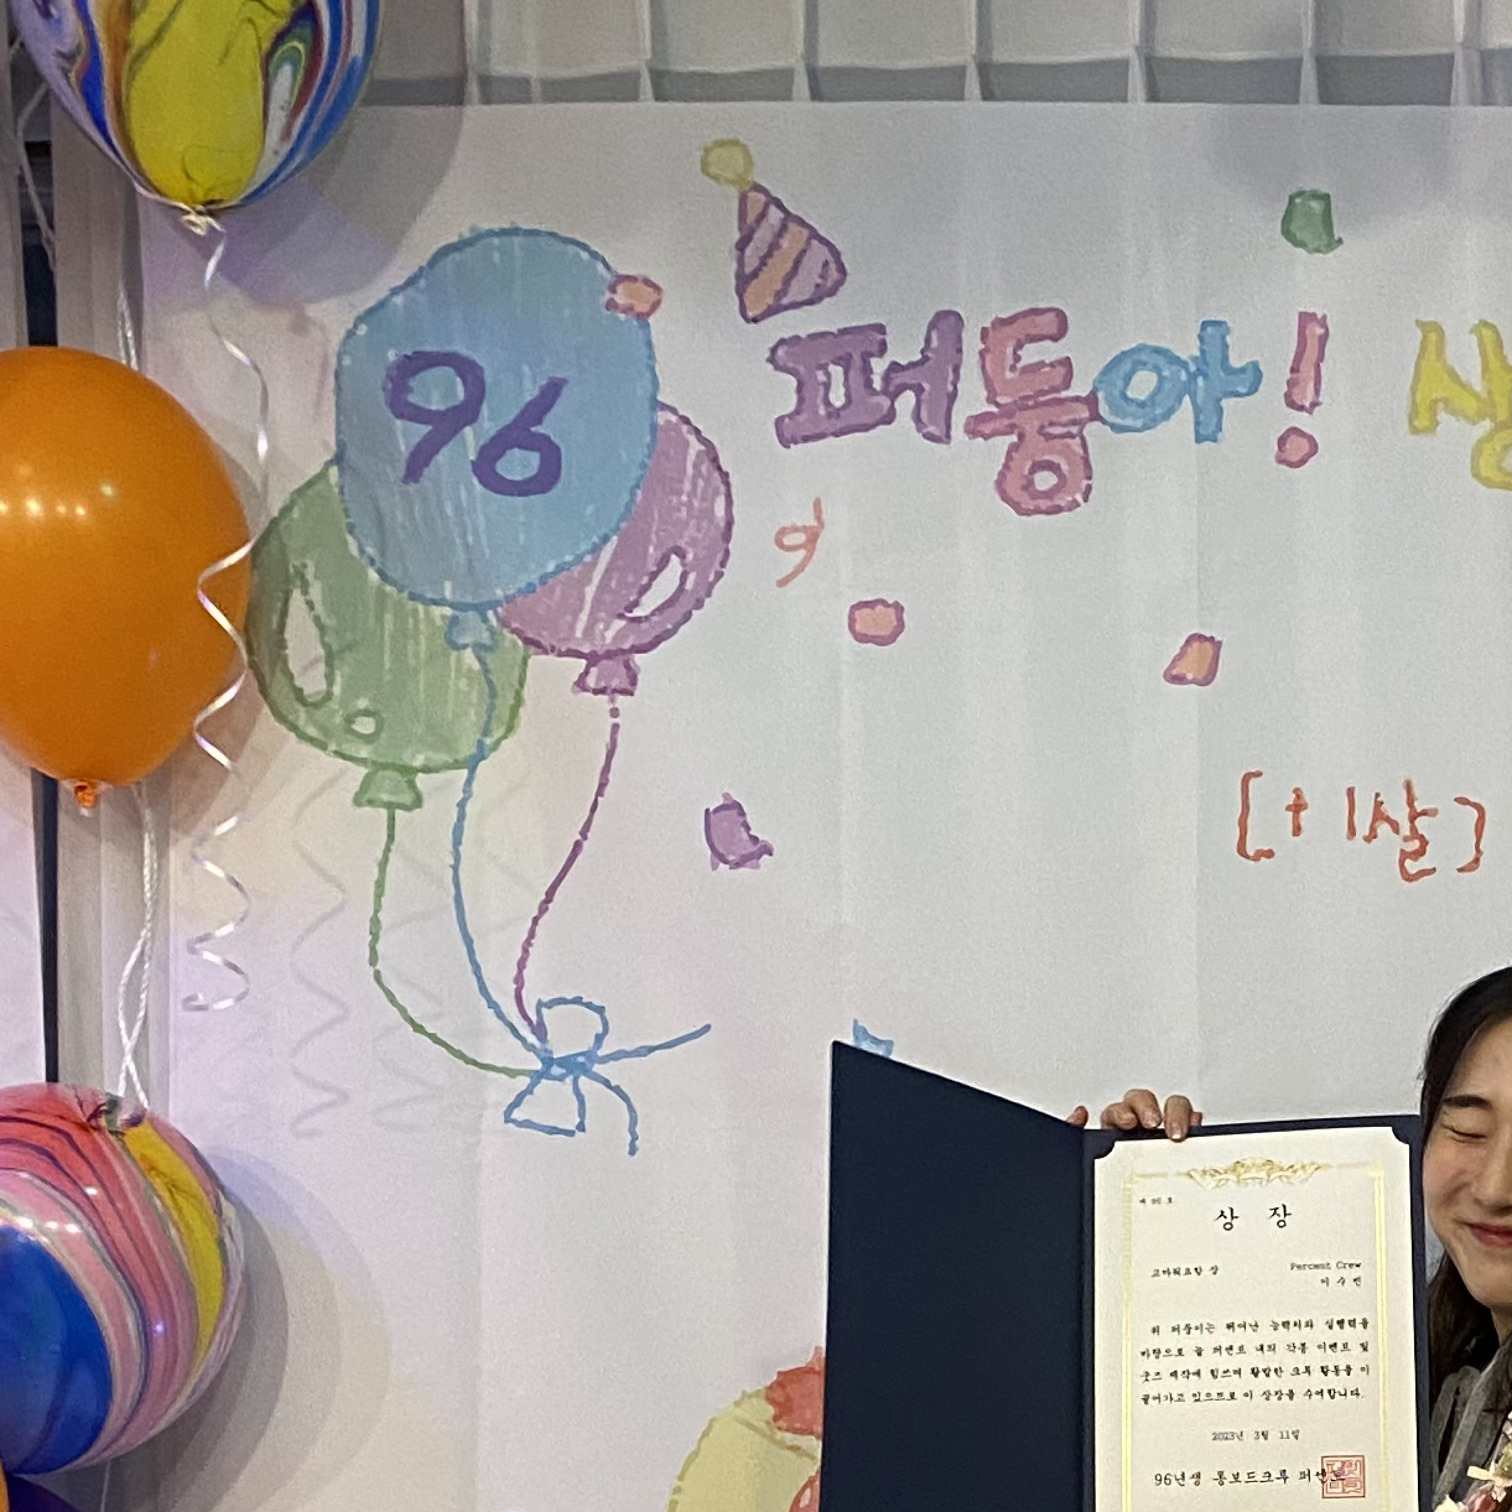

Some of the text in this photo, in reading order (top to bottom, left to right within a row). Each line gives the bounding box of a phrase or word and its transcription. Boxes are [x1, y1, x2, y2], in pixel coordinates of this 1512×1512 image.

[382, 350, 569, 497] 96
[1214, 1203, 1293, 1231] 상 장
[1290, 1260, 1362, 1271] Percent Crew
[1242, 1390, 1254, 1402] 이
[1154, 1470, 1202, 1487] 96년생
